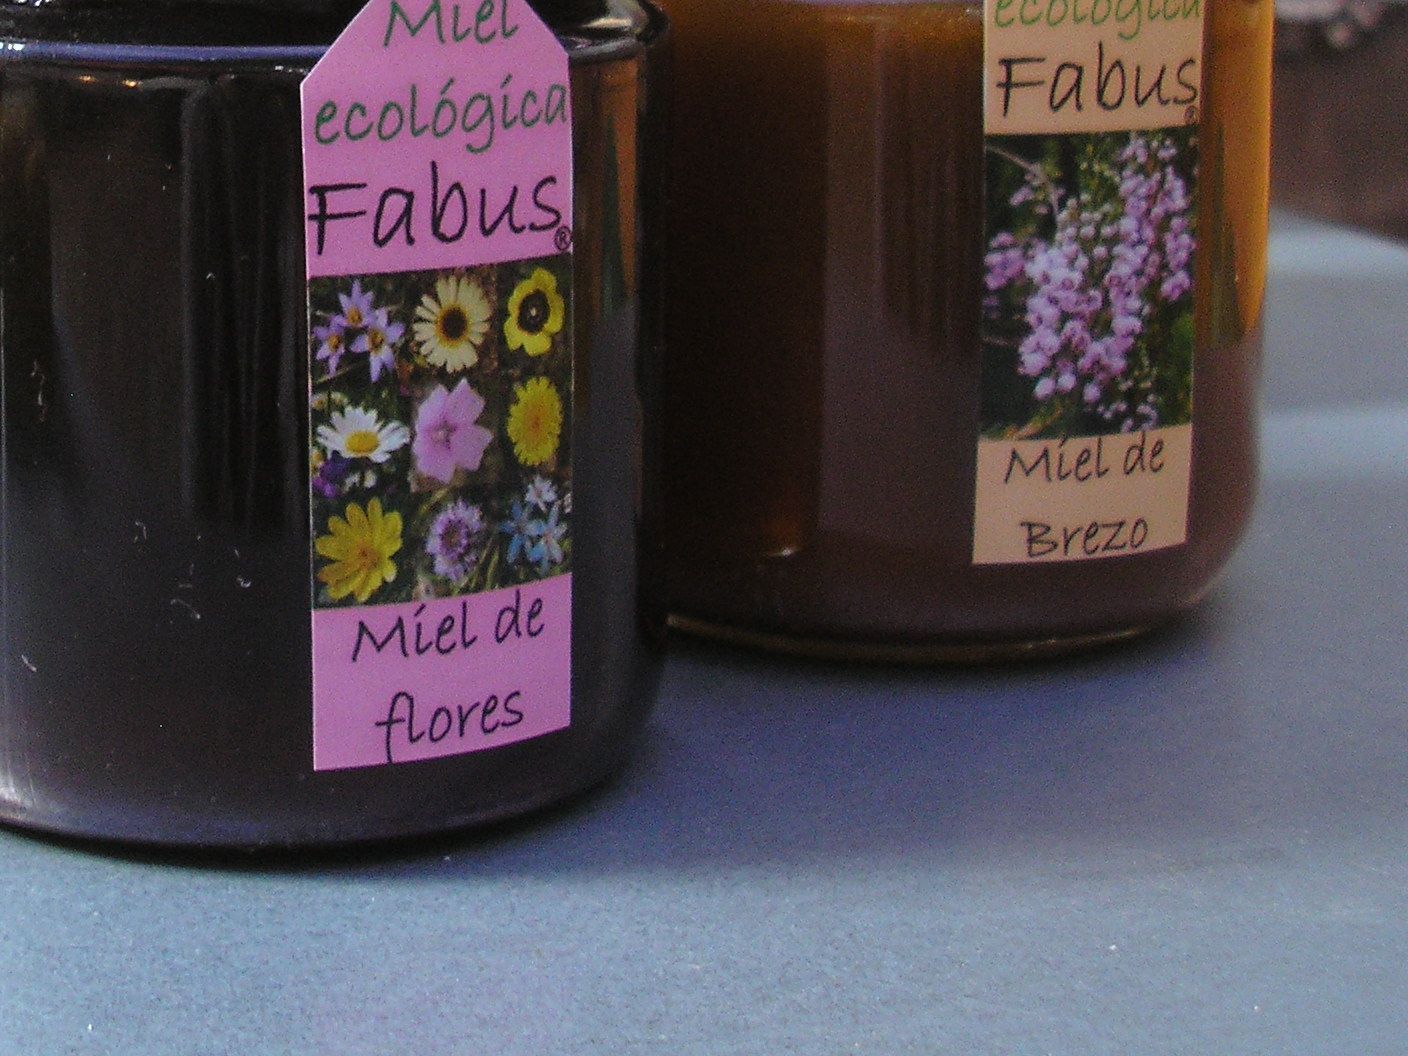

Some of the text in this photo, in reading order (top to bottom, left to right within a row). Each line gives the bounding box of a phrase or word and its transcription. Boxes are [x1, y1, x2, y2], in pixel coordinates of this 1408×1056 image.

[1122, 429, 1165, 476] de
[1020, 516, 1149, 559] Brezo
[494, 588, 545, 645] de
[374, 690, 524, 764] flores
